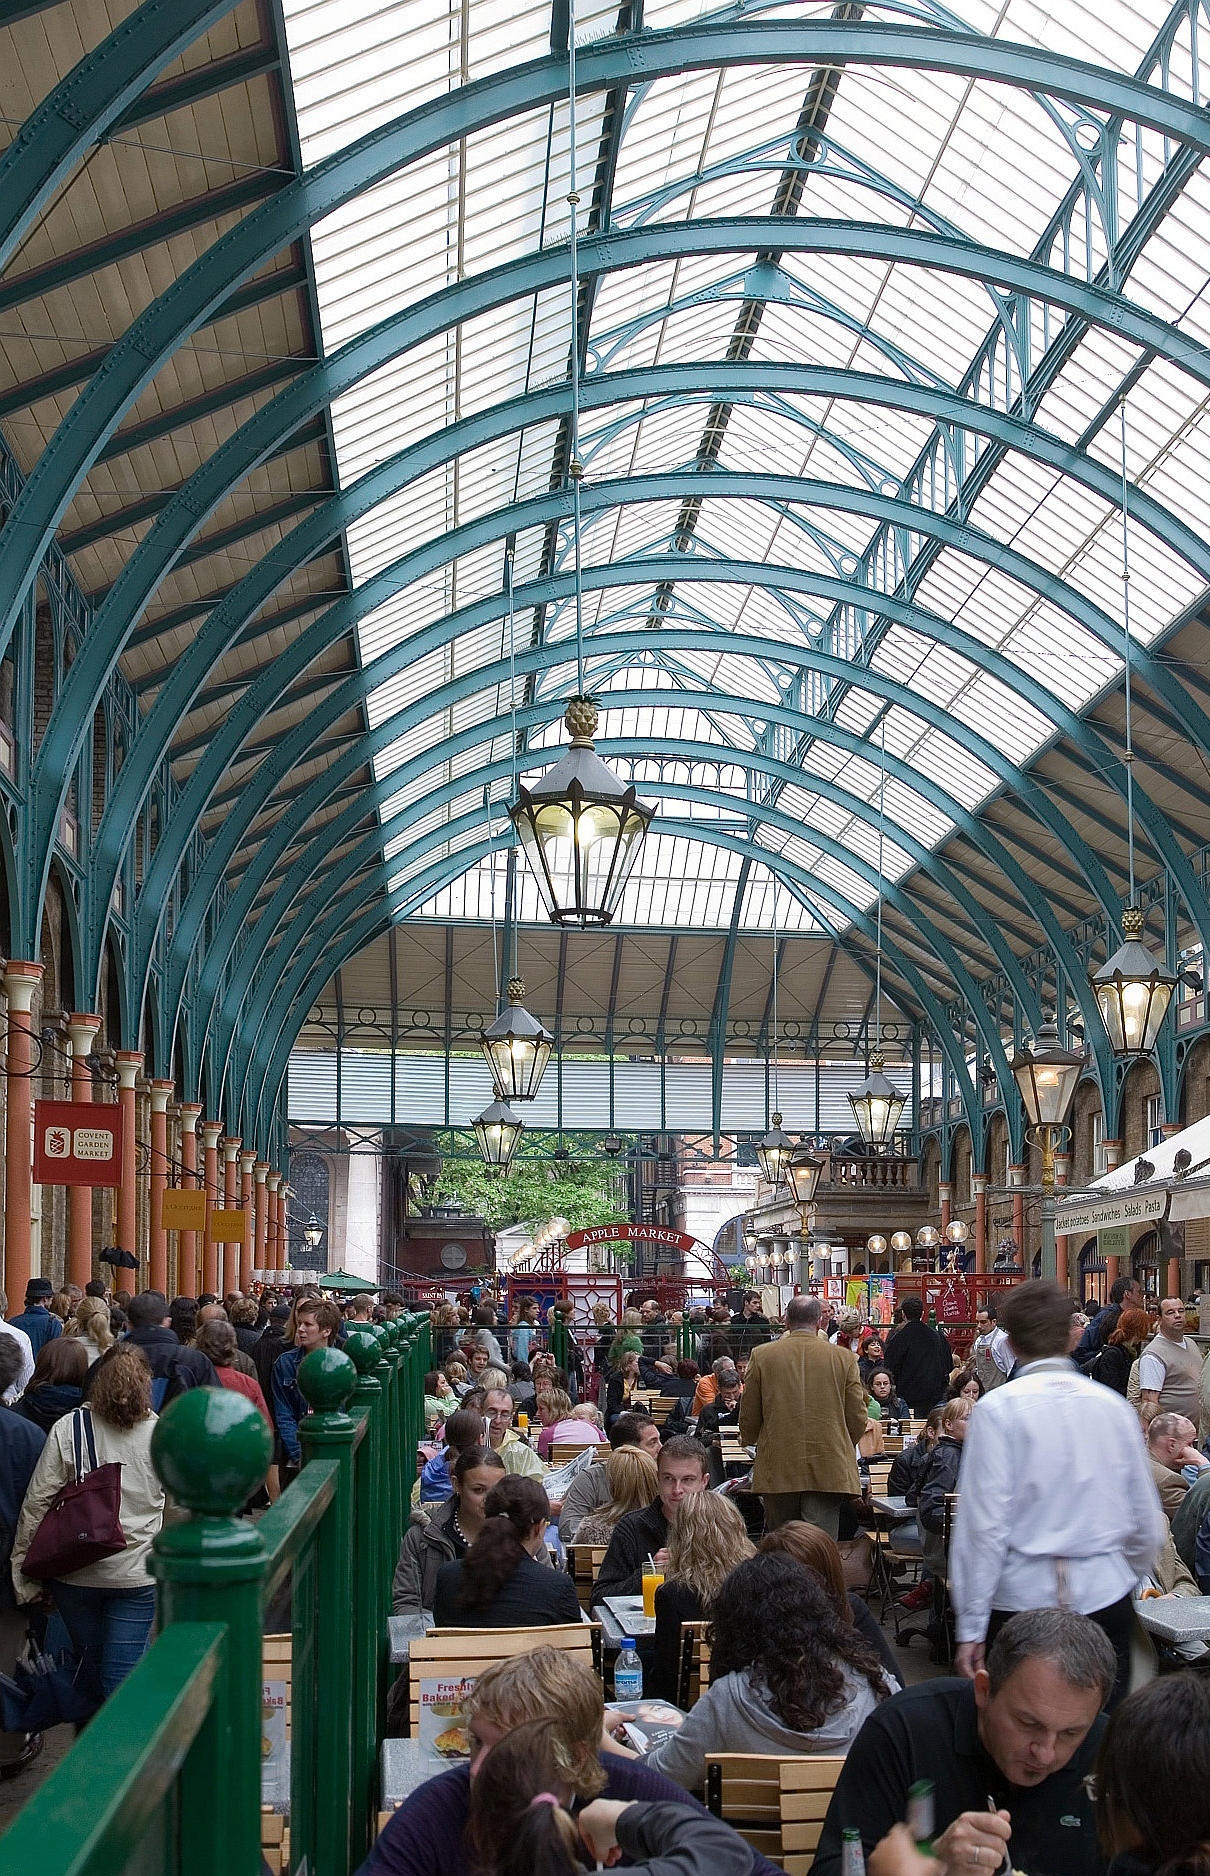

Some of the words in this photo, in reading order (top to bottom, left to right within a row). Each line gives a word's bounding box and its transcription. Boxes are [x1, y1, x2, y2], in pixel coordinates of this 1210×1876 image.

[78, 1132, 110, 1140] COVENT
[78, 1141, 110, 1149] GARDEN
[1055, 1217, 1070, 1230] Jacket
[1070, 1214, 1089, 1231] potatoes
[1092, 1208, 1120, 1223] Sandwiches
[1125, 1202, 1142, 1217] Salads
[1145, 1200, 1161, 1213] Pasta
[582, 1227, 620, 1243] APPLE
[627, 1227, 682, 1244] MARKET
[422, 1693, 455, 1702] Baked
